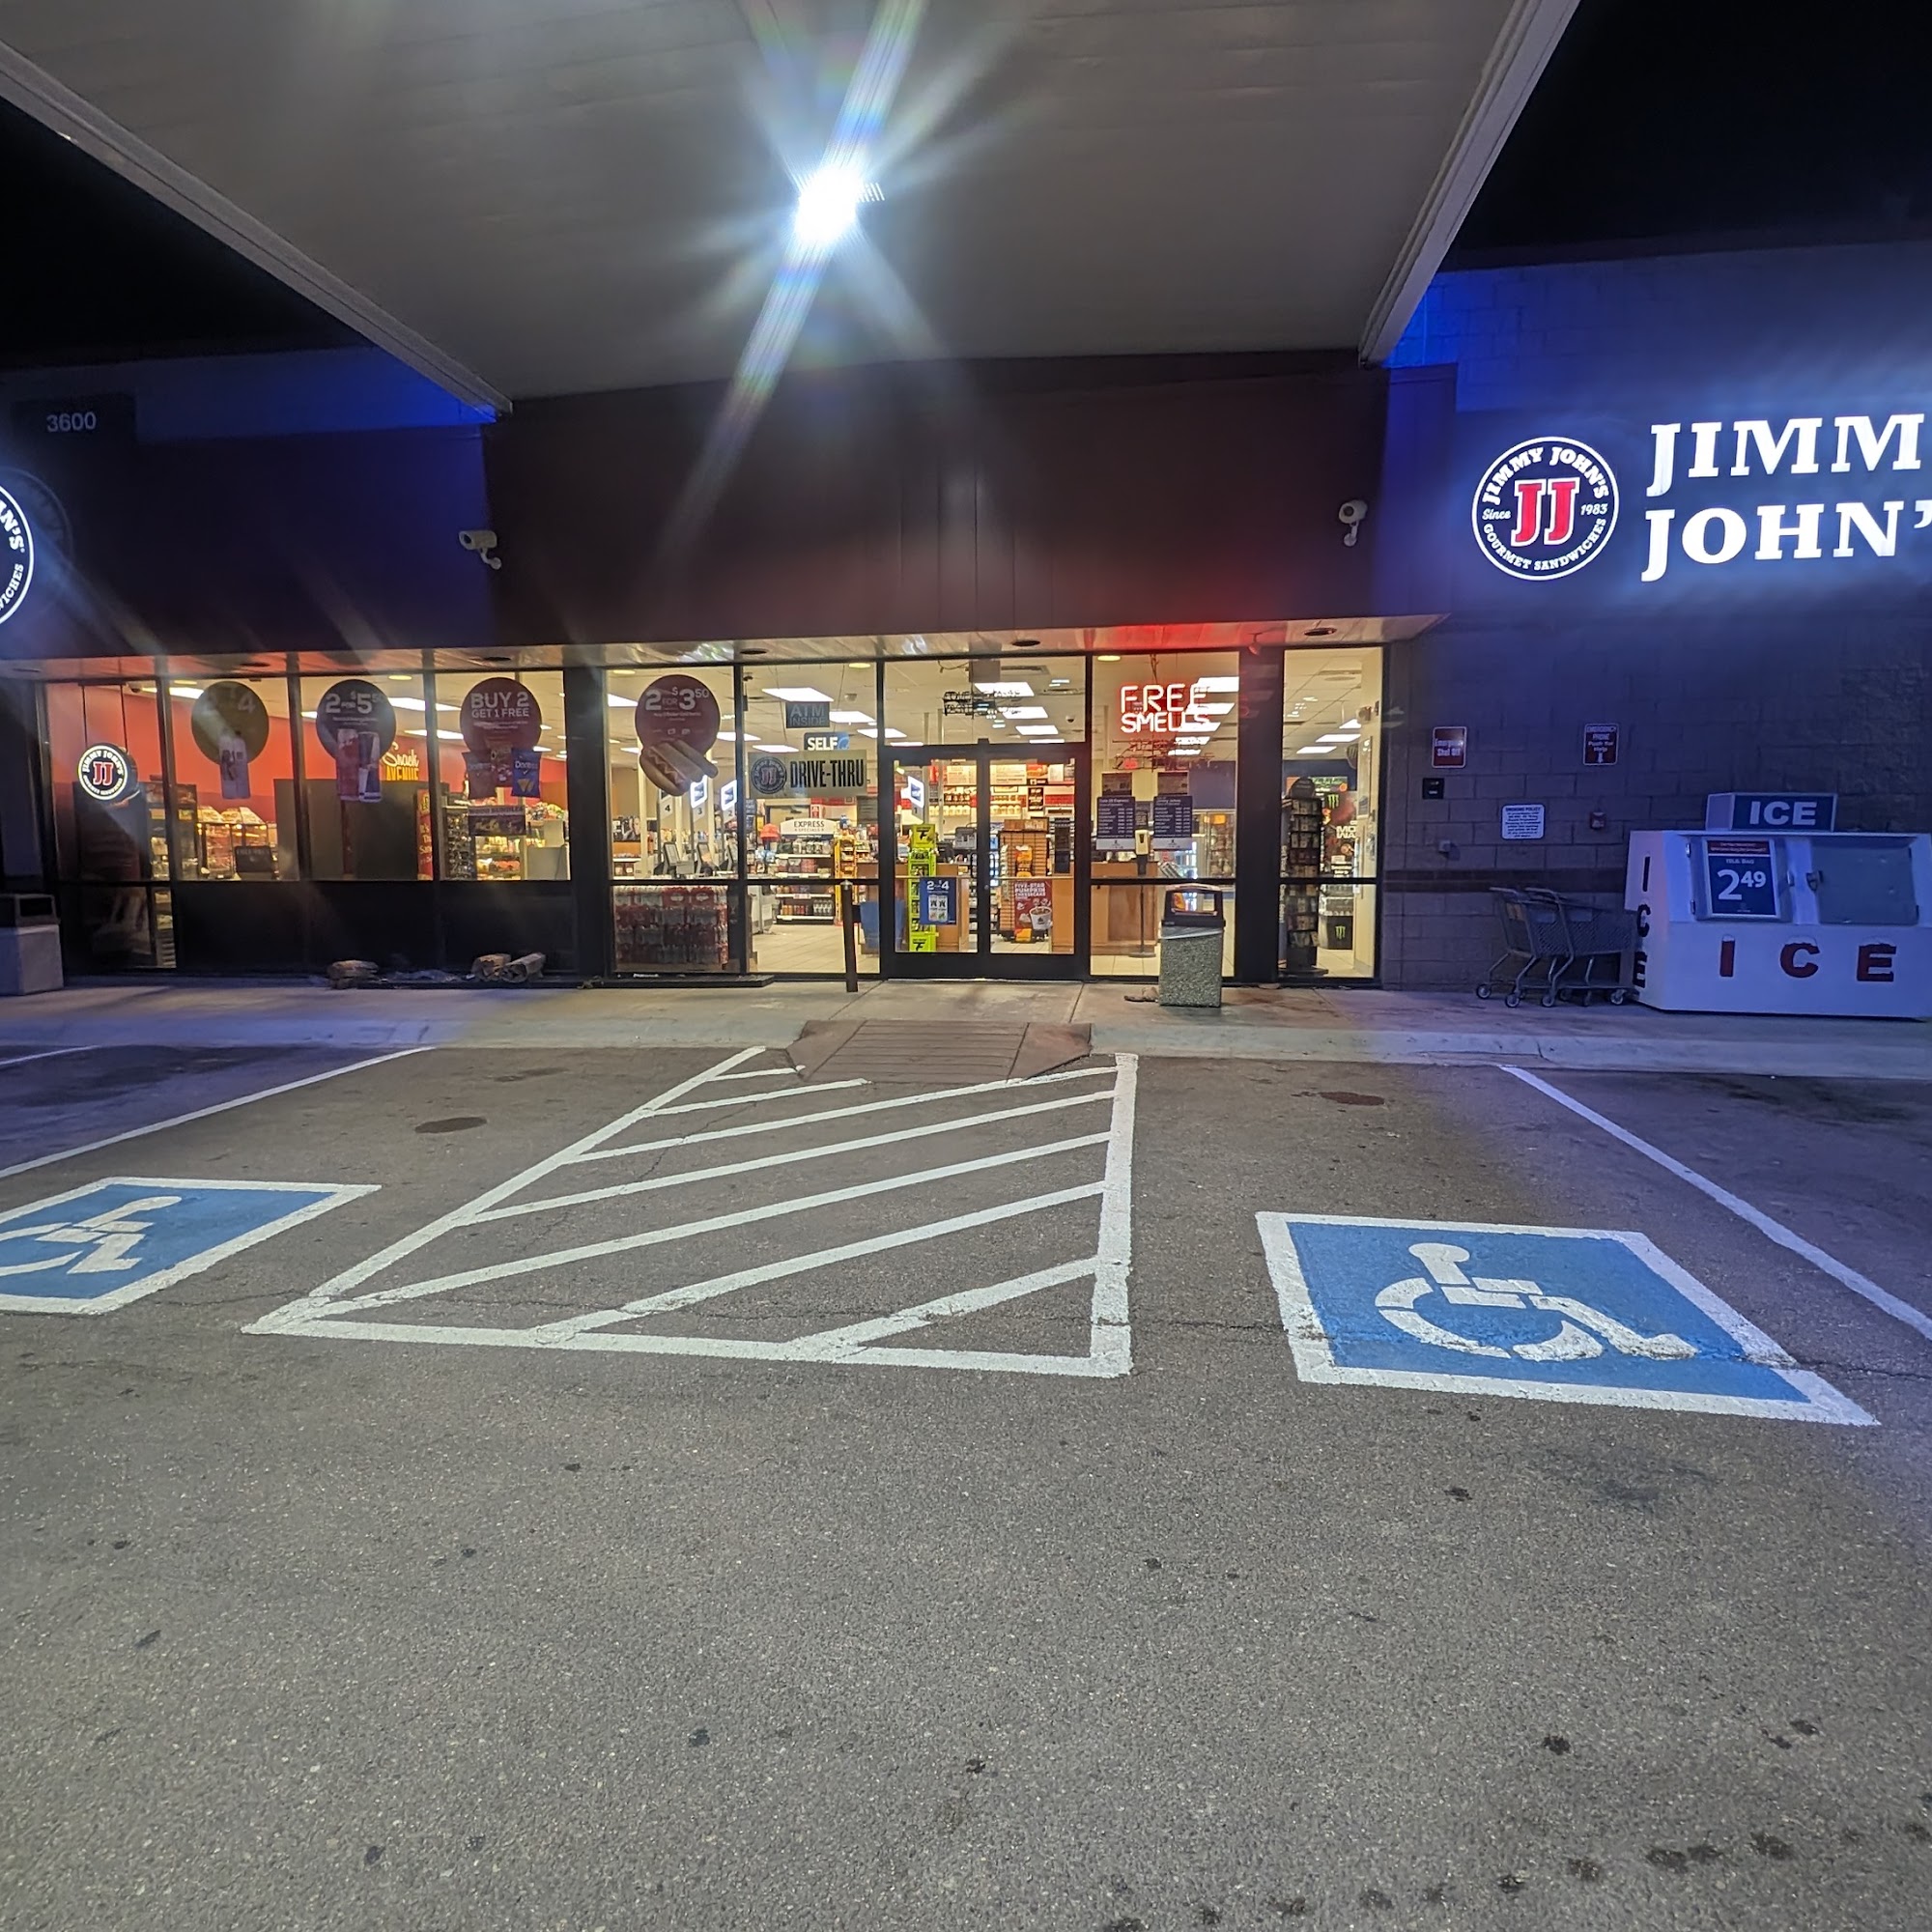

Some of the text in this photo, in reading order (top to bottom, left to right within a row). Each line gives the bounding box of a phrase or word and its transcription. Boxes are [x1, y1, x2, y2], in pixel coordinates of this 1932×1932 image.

[46, 411, 97, 433] 3600
[1646, 412, 1925, 497] JIMM
[1482, 446, 1609, 505] JIMMY JOHN'S
[1482, 503, 1608, 521] Since 1983
[1510, 476, 1580, 547] JJ
[1483, 518, 1607, 570] GOURMET SANDWICHES
[325, 693, 341, 714] 2
[470, 690, 530, 708] BUY 2
[644, 688, 662, 711] 2
[1121, 683, 1208, 714] FREE
[471, 707, 530, 718] GET 1 FREE
[788, 716, 826, 727] INSIDE
[789, 703, 825, 718] ATM
[1121, 711, 1210, 733] SMELLS
[382, 741, 420, 768] Snack
[807, 736, 838, 751] SELF
[92, 760, 114, 786] JJ
[789, 758, 865, 788] DRIVE-THRU
[665, 804, 671, 812] 4
[697, 807, 703, 815] 3
[1748, 800, 1818, 826] ICE
[793, 819, 825, 829] EXPRESS
[926, 880, 935, 891] 2
